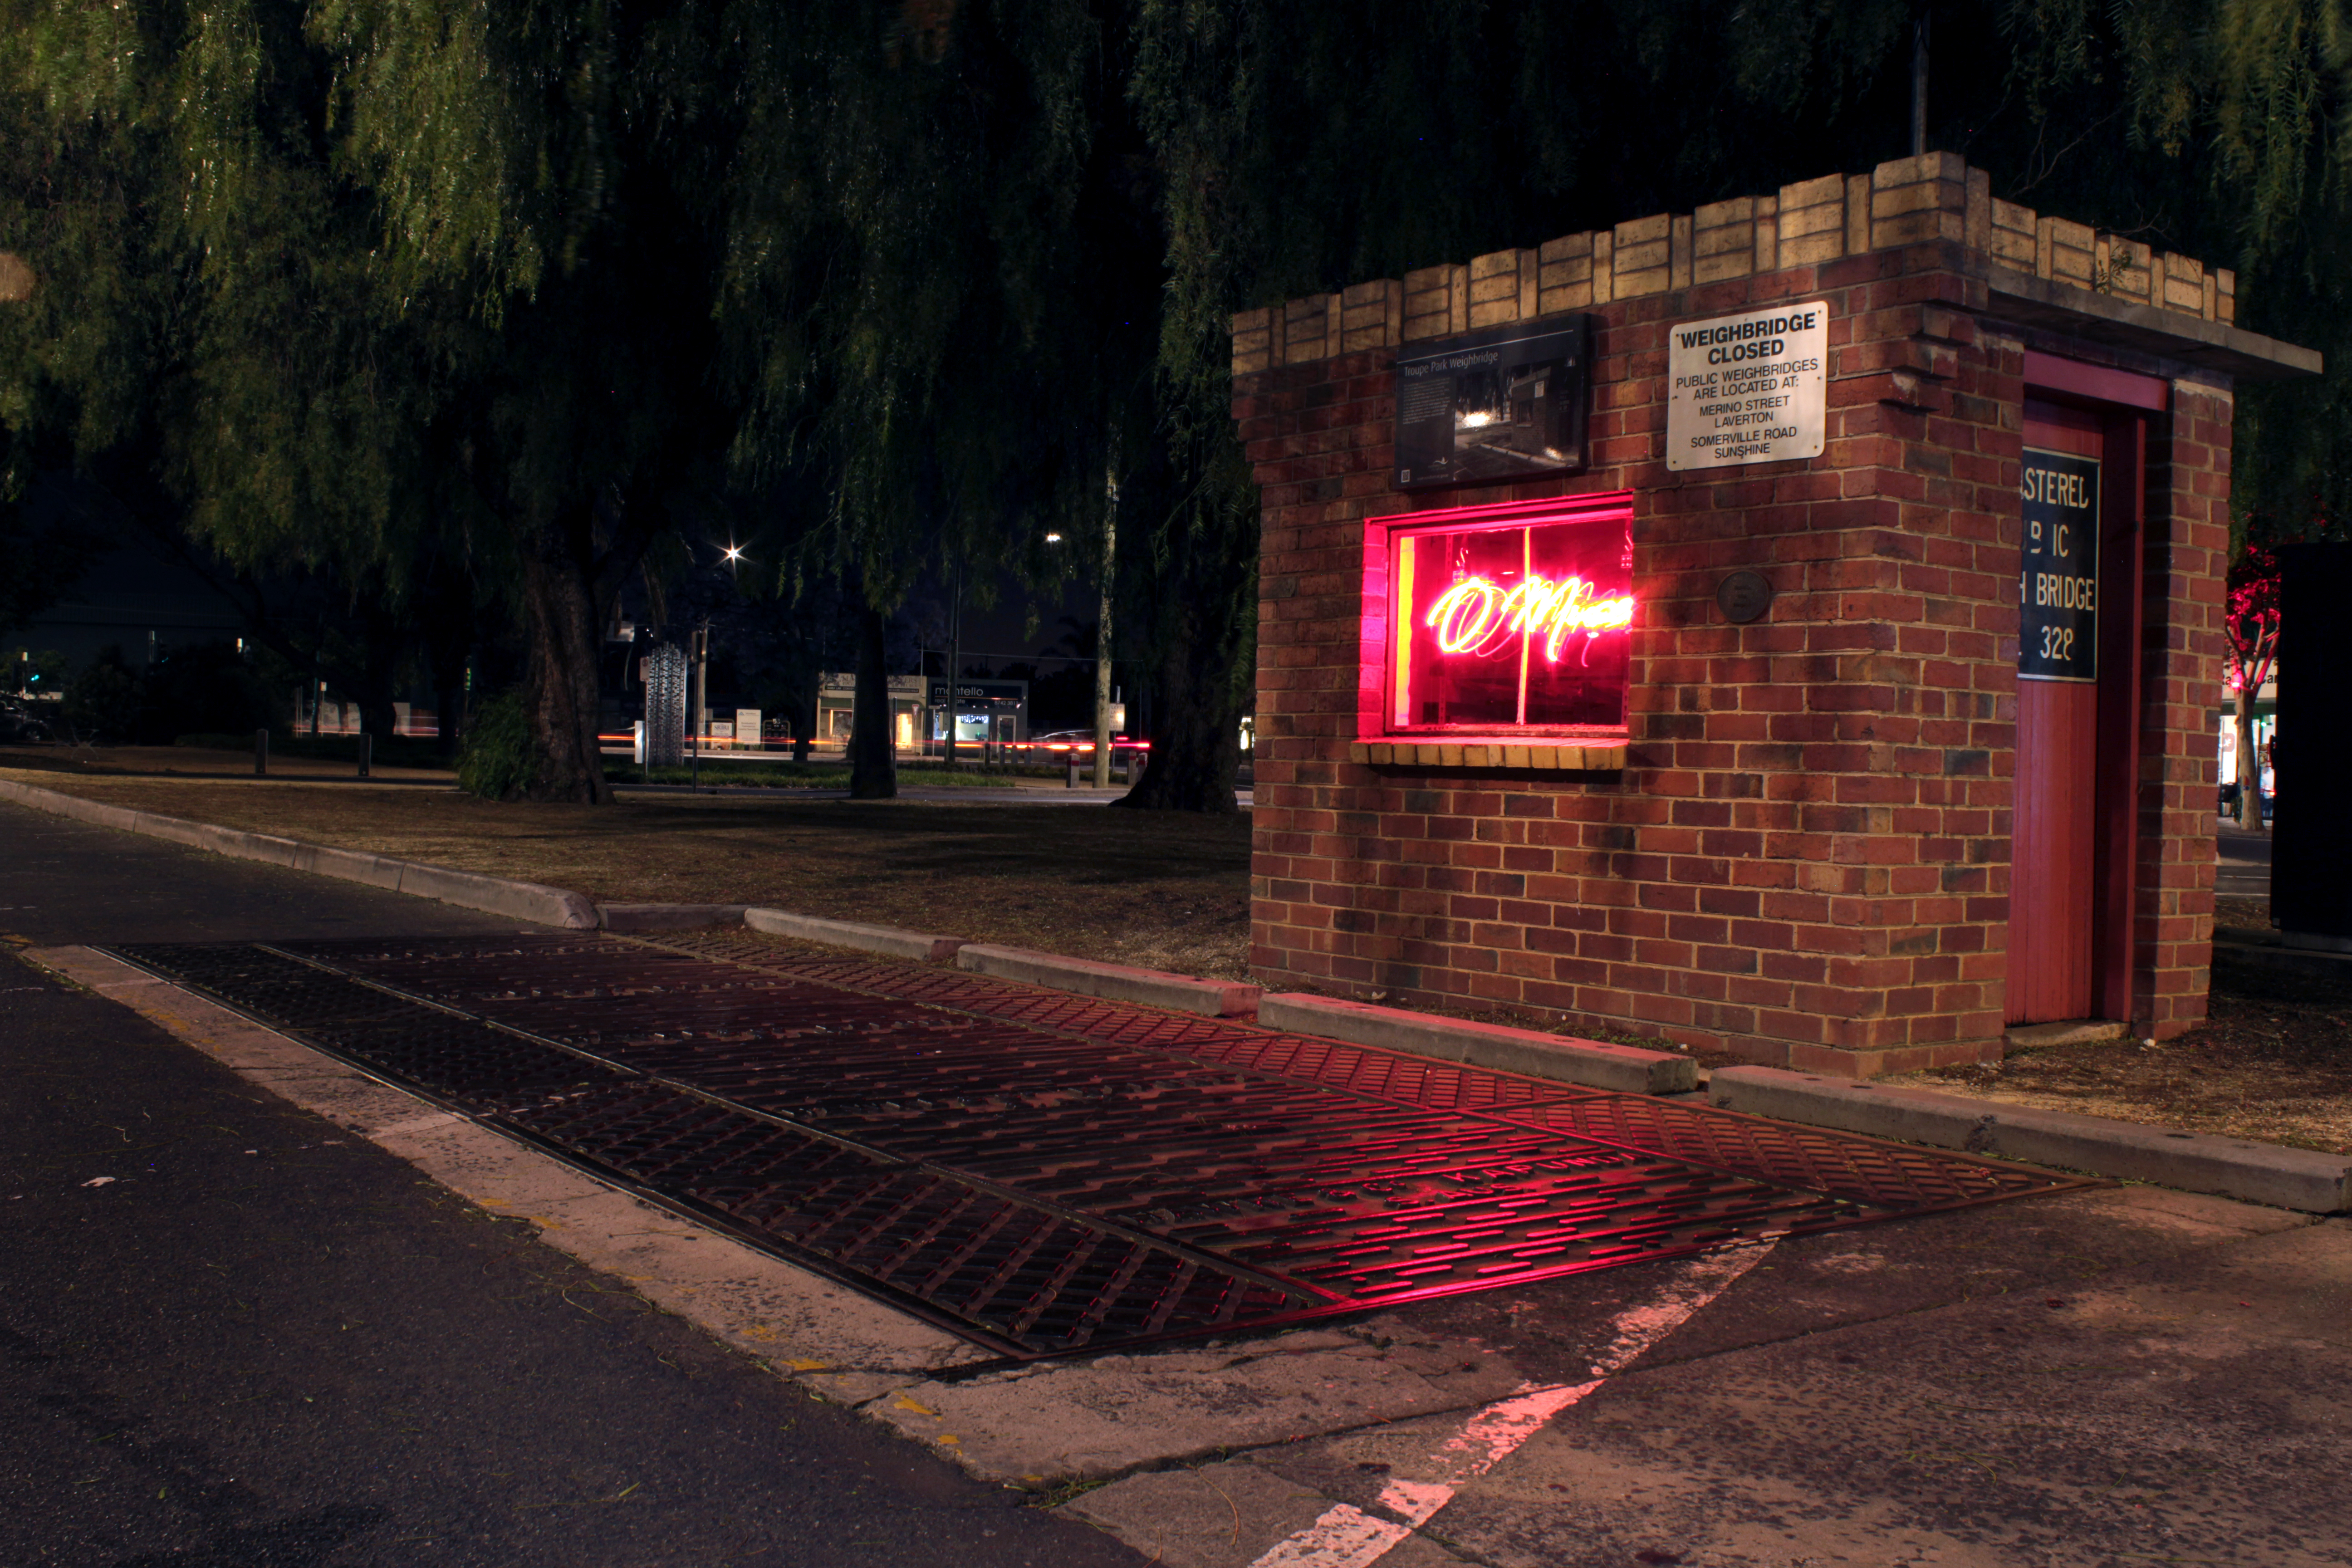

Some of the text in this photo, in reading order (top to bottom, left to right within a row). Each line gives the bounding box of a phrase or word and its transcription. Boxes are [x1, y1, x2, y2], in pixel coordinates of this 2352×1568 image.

[1681, 312, 1816, 349] WEIGHBRIDGE
[1405, 351, 1499, 377] Troupe Park Weighbridge
[1708, 339, 1784, 365] CLOSED
[1676, 358, 1818, 389] PUBLIC WEIGHBRIDGES
[1693, 376, 1799, 400] ARE LOCATED AT:
[1700, 395, 1790, 416] MERINO STREET
[1715, 412, 1774, 428] LAVERTON
[1691, 426, 1797, 447] SOMERVILLE ROAD
[1715, 443, 1770, 458] SUNSHINE
[2036, 572, 2095, 611] BRIDGE
